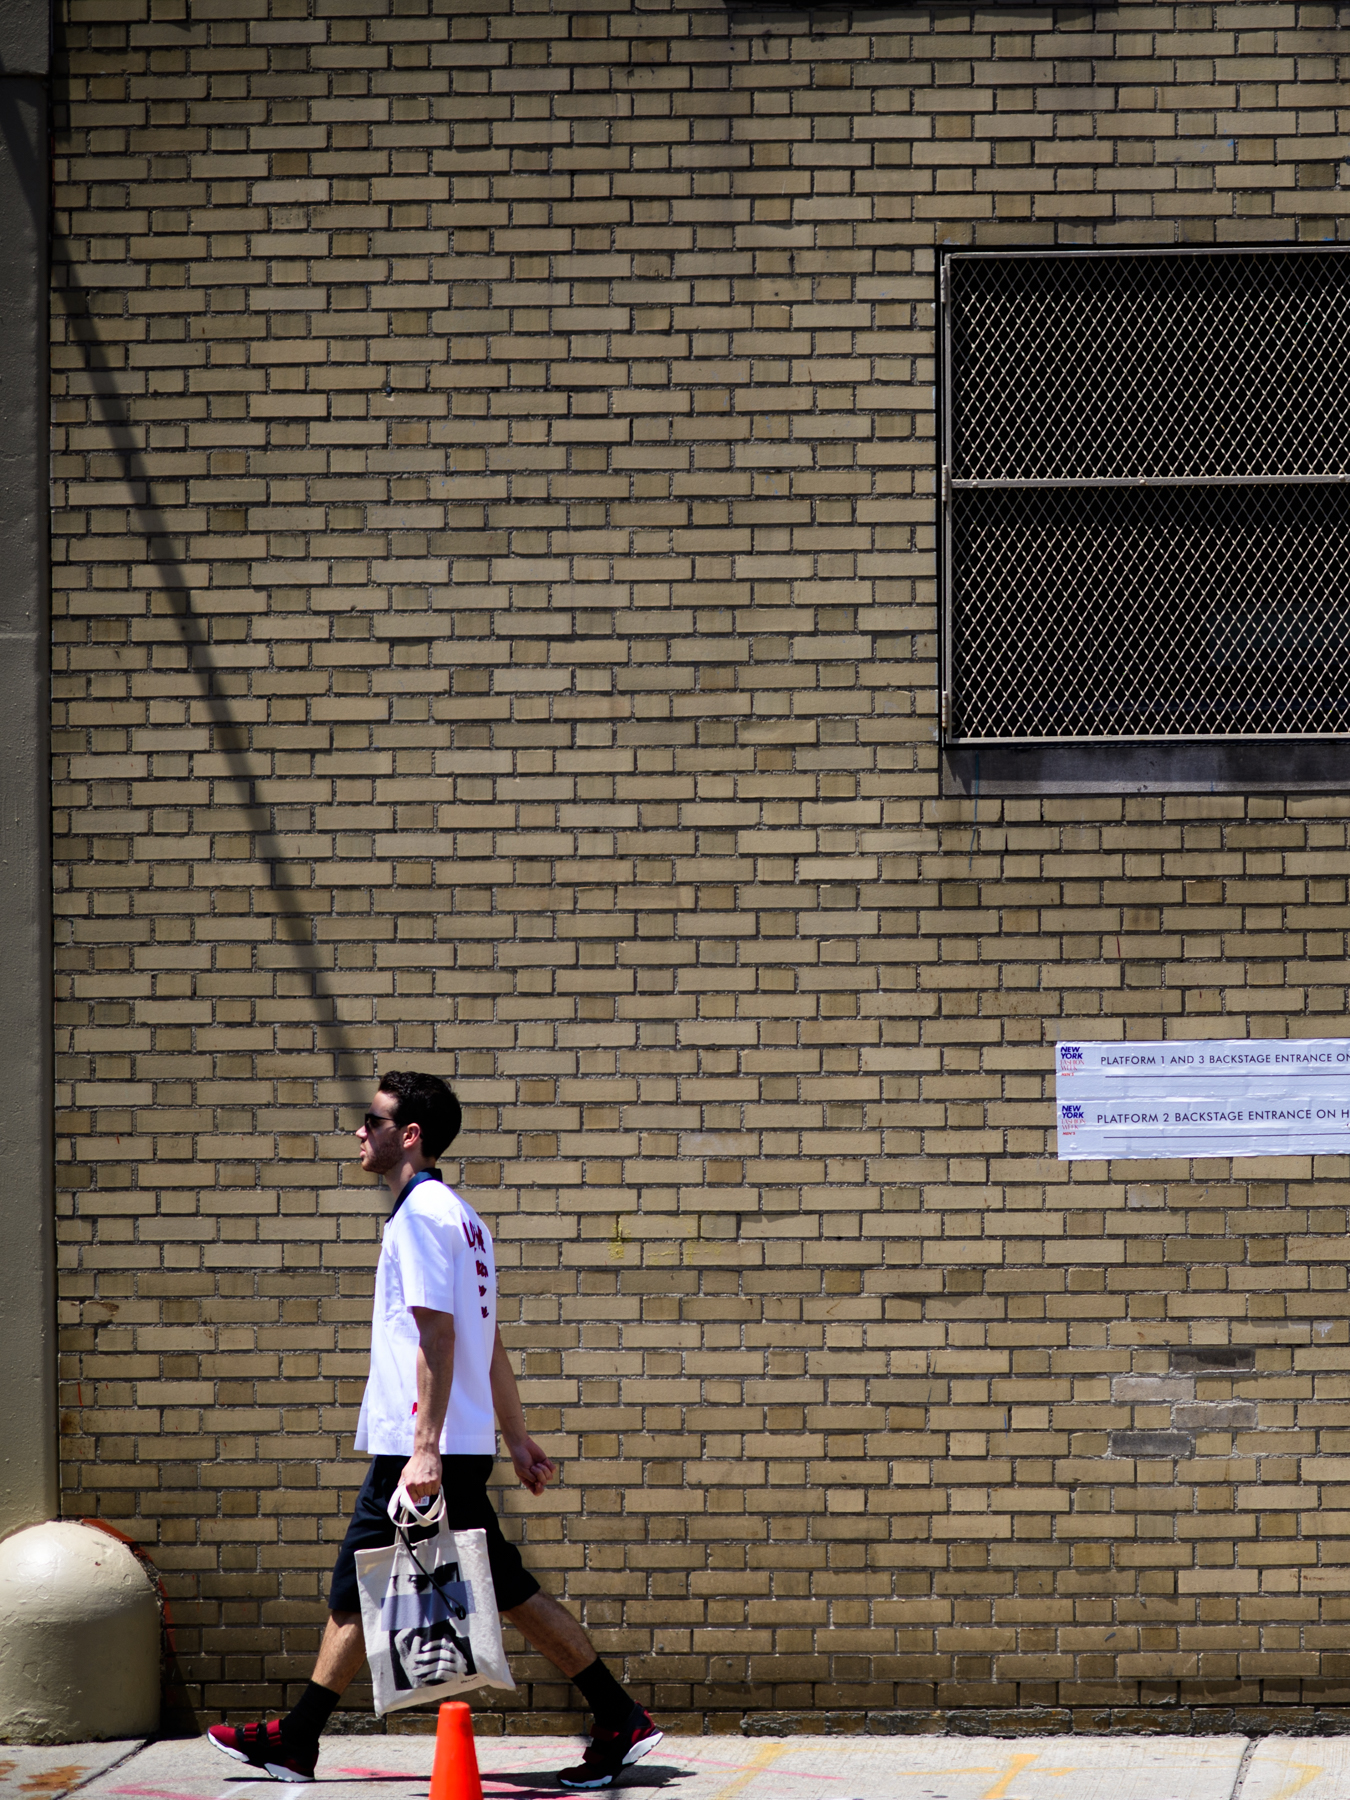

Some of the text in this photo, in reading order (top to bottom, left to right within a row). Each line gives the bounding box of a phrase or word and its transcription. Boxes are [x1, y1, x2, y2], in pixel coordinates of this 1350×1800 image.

[1101, 1056, 1156, 1065] PLATFORM
[1160, 1056, 1165, 1064] 1
[1170, 1055, 1194, 1064] AND
[1199, 1055, 1205, 1064] 3
[1209, 1054, 1271, 1064] BACKSTAGE
[1275, 1053, 1332, 1063] ENTRANCE
[1097, 1113, 1158, 1124] PLATFORM
[1163, 1113, 1170, 1122] 2
[1175, 1111, 1244, 1122] BACKSTAGE
[1248, 1109, 1312, 1121] ENTRANCE
[1316, 1109, 1336, 1119] ON
